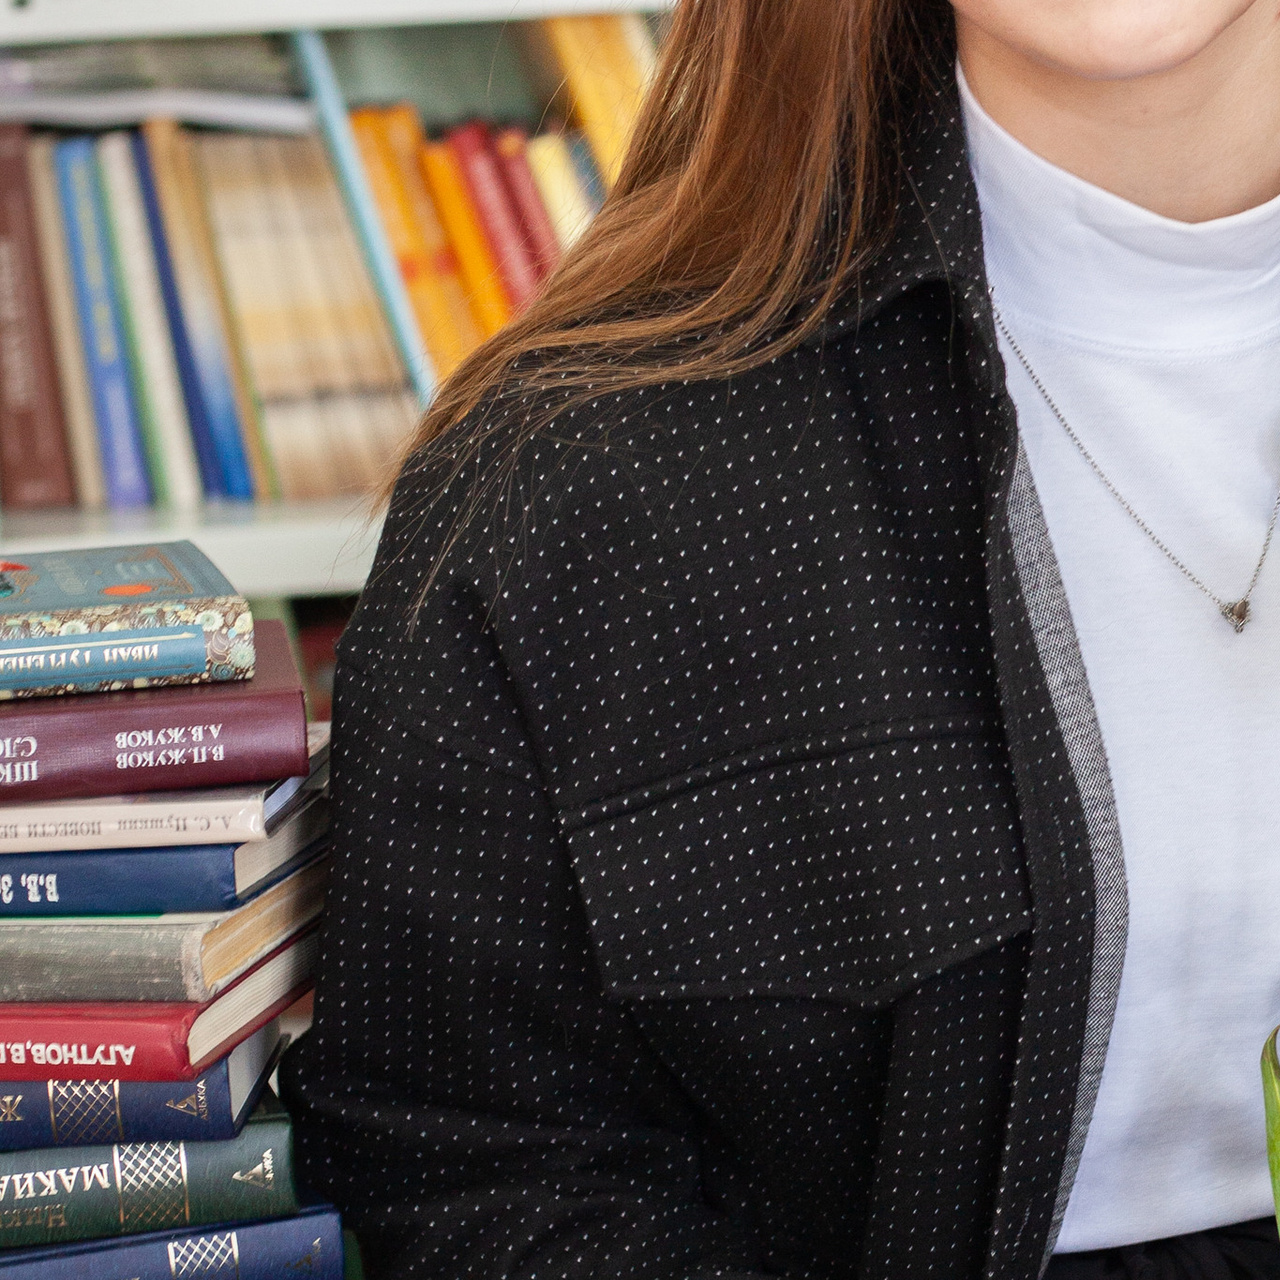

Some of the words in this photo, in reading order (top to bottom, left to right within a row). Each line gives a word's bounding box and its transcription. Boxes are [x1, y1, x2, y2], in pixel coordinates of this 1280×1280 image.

[104, 642, 160, 665] ИВАН
[116, 744, 225, 770] В.П.ЖУКОВ
[27, 821, 101, 839] ПОВЕСТИ
[0, 872, 14, 905] З
[196, 1077, 209, 1121] АЗБУКА
